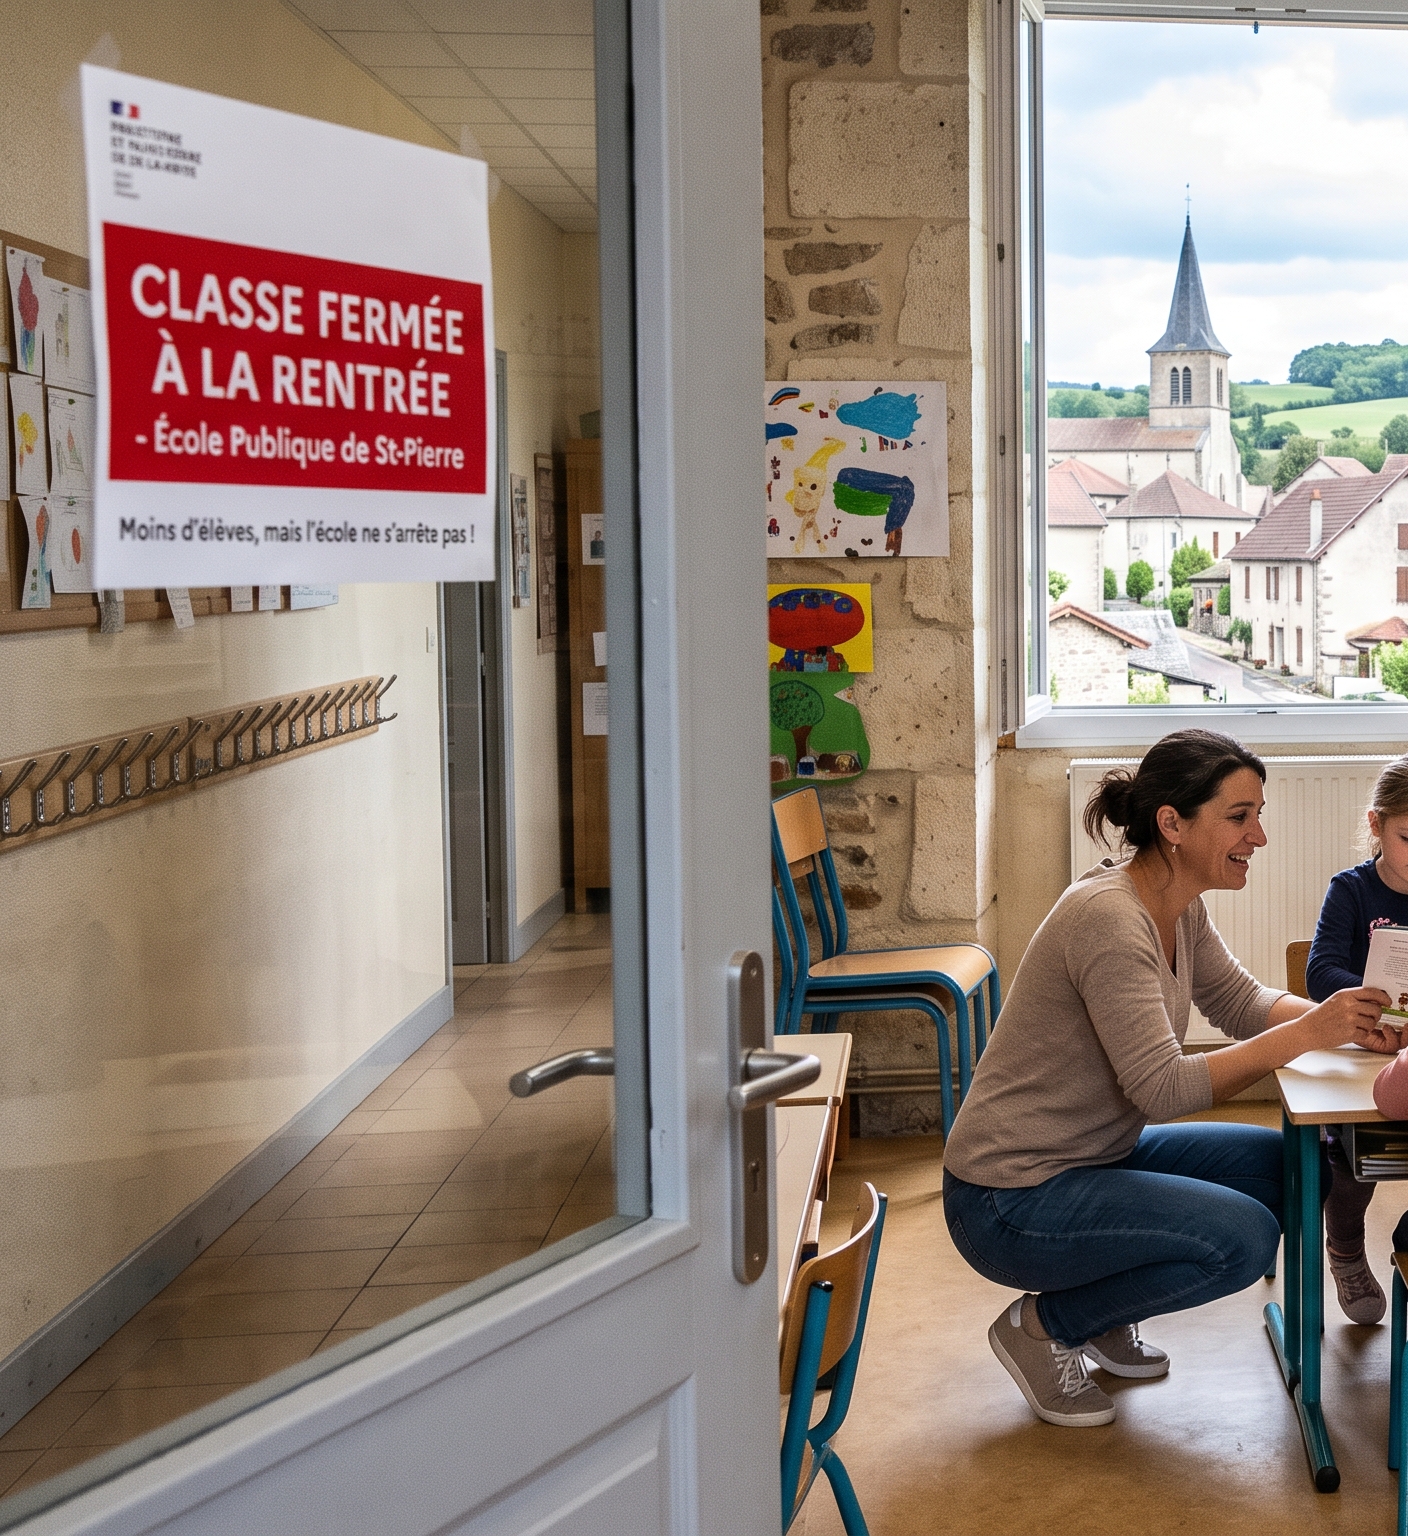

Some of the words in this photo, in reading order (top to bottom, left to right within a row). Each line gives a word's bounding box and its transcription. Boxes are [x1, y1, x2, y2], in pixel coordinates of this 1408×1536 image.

[131, 264, 304, 335] CLASSE
[319, 291, 464, 354] FERMÉE
[152, 329, 188, 395] À
[202, 348, 260, 401] LA
[273, 355, 450, 417] RENTRÉE
[154, 413, 223, 456] École
[230, 425, 335, 469] Publique
[341, 432, 369, 464] de
[375, 435, 464, 469] St-Pierre
[120, 517, 176, 541] Moins
[181, 518, 259, 545] d'élèves,
[264, 520, 302, 542] mais
[307, 521, 357, 542] l'école
[362, 527, 380, 543] ne
[385, 523, 438, 543] s'arrête
[443, 529, 466, 549] pas
